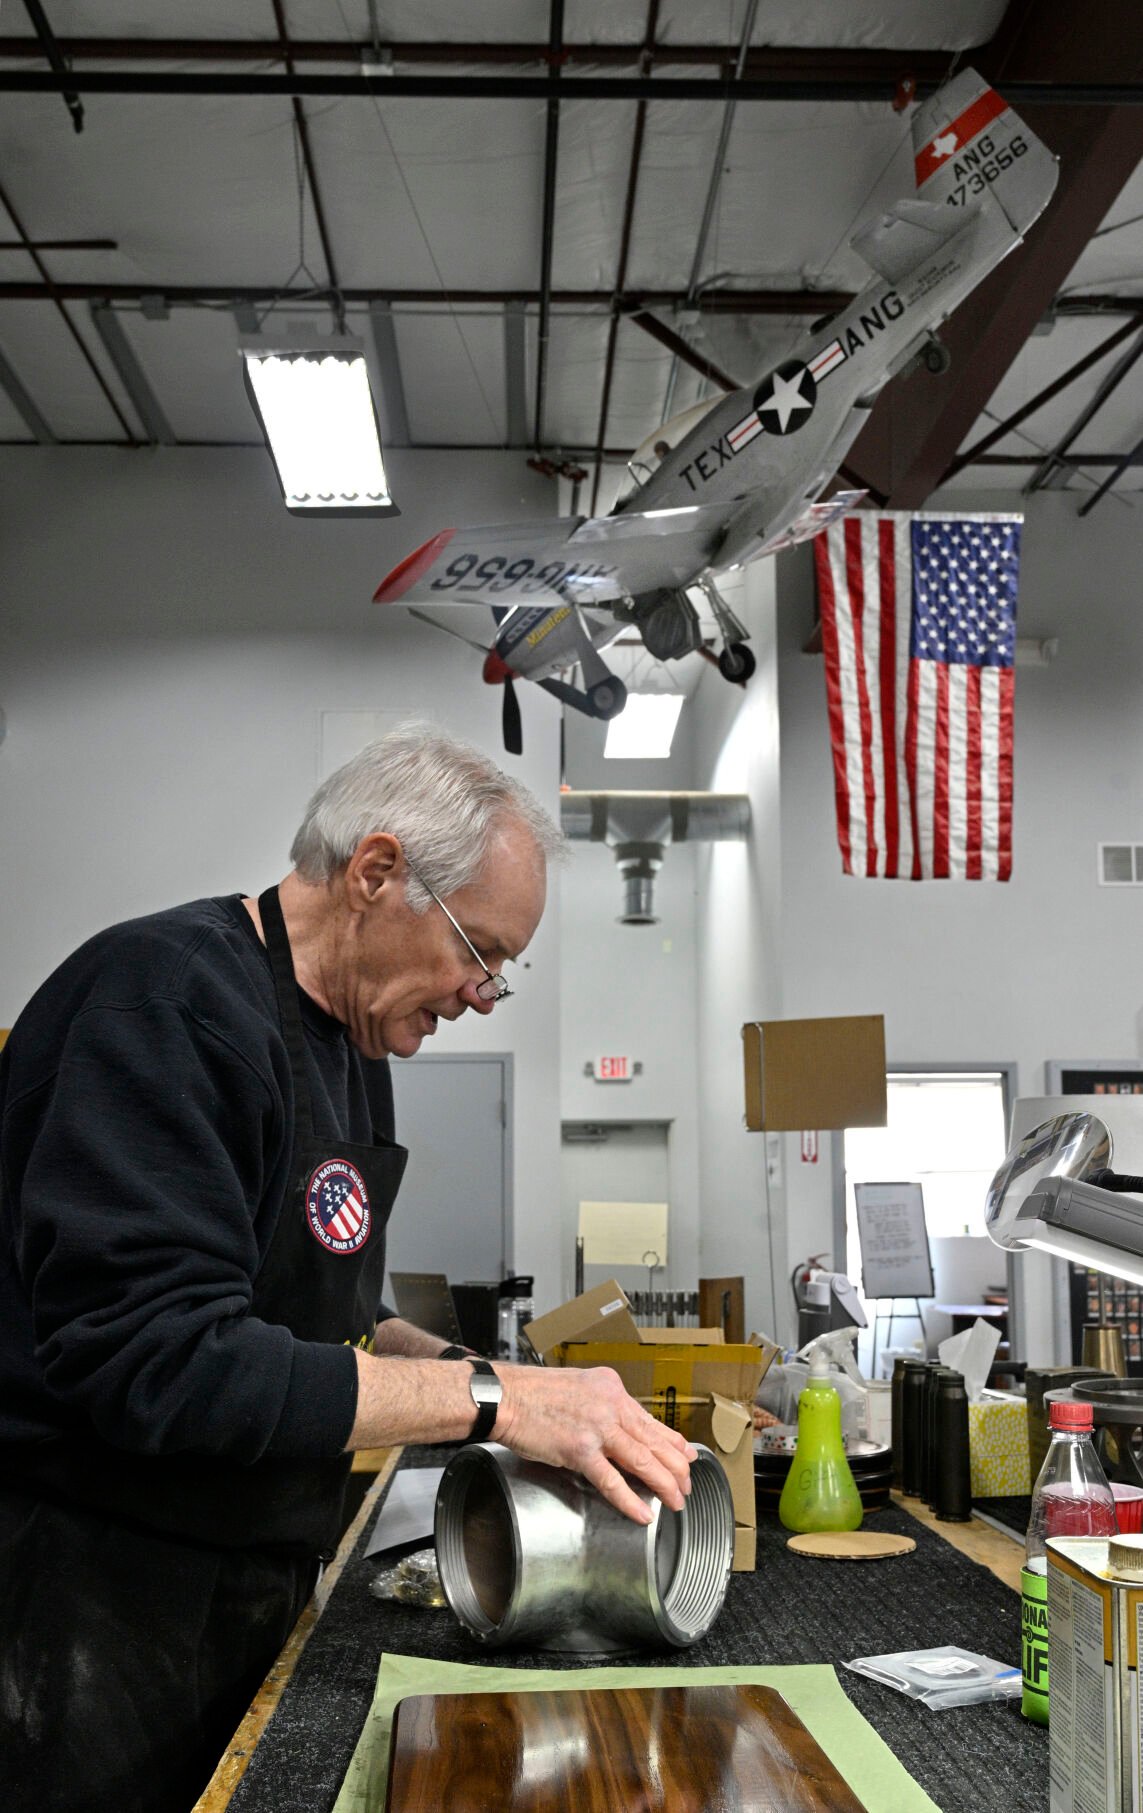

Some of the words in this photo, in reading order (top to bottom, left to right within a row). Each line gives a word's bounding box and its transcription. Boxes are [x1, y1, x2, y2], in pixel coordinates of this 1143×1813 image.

[953, 135, 995, 182] ANG
[846, 290, 905, 355] ANG
[679, 438, 732, 491] TEX
[601, 1056, 628, 1079] EXIT
[311, 1180, 321, 1194] THE
[319, 1163, 349, 1180] NATIONAL
[349, 1169, 368, 1203] MUSEUM
[309, 1202, 317, 1214] OF
[312, 1216, 331, 1243] WORLD
[354, 1209, 369, 1245] AVIATION
[332, 1240, 348, 1250] WAR
[349, 1241, 354, 1249] II
